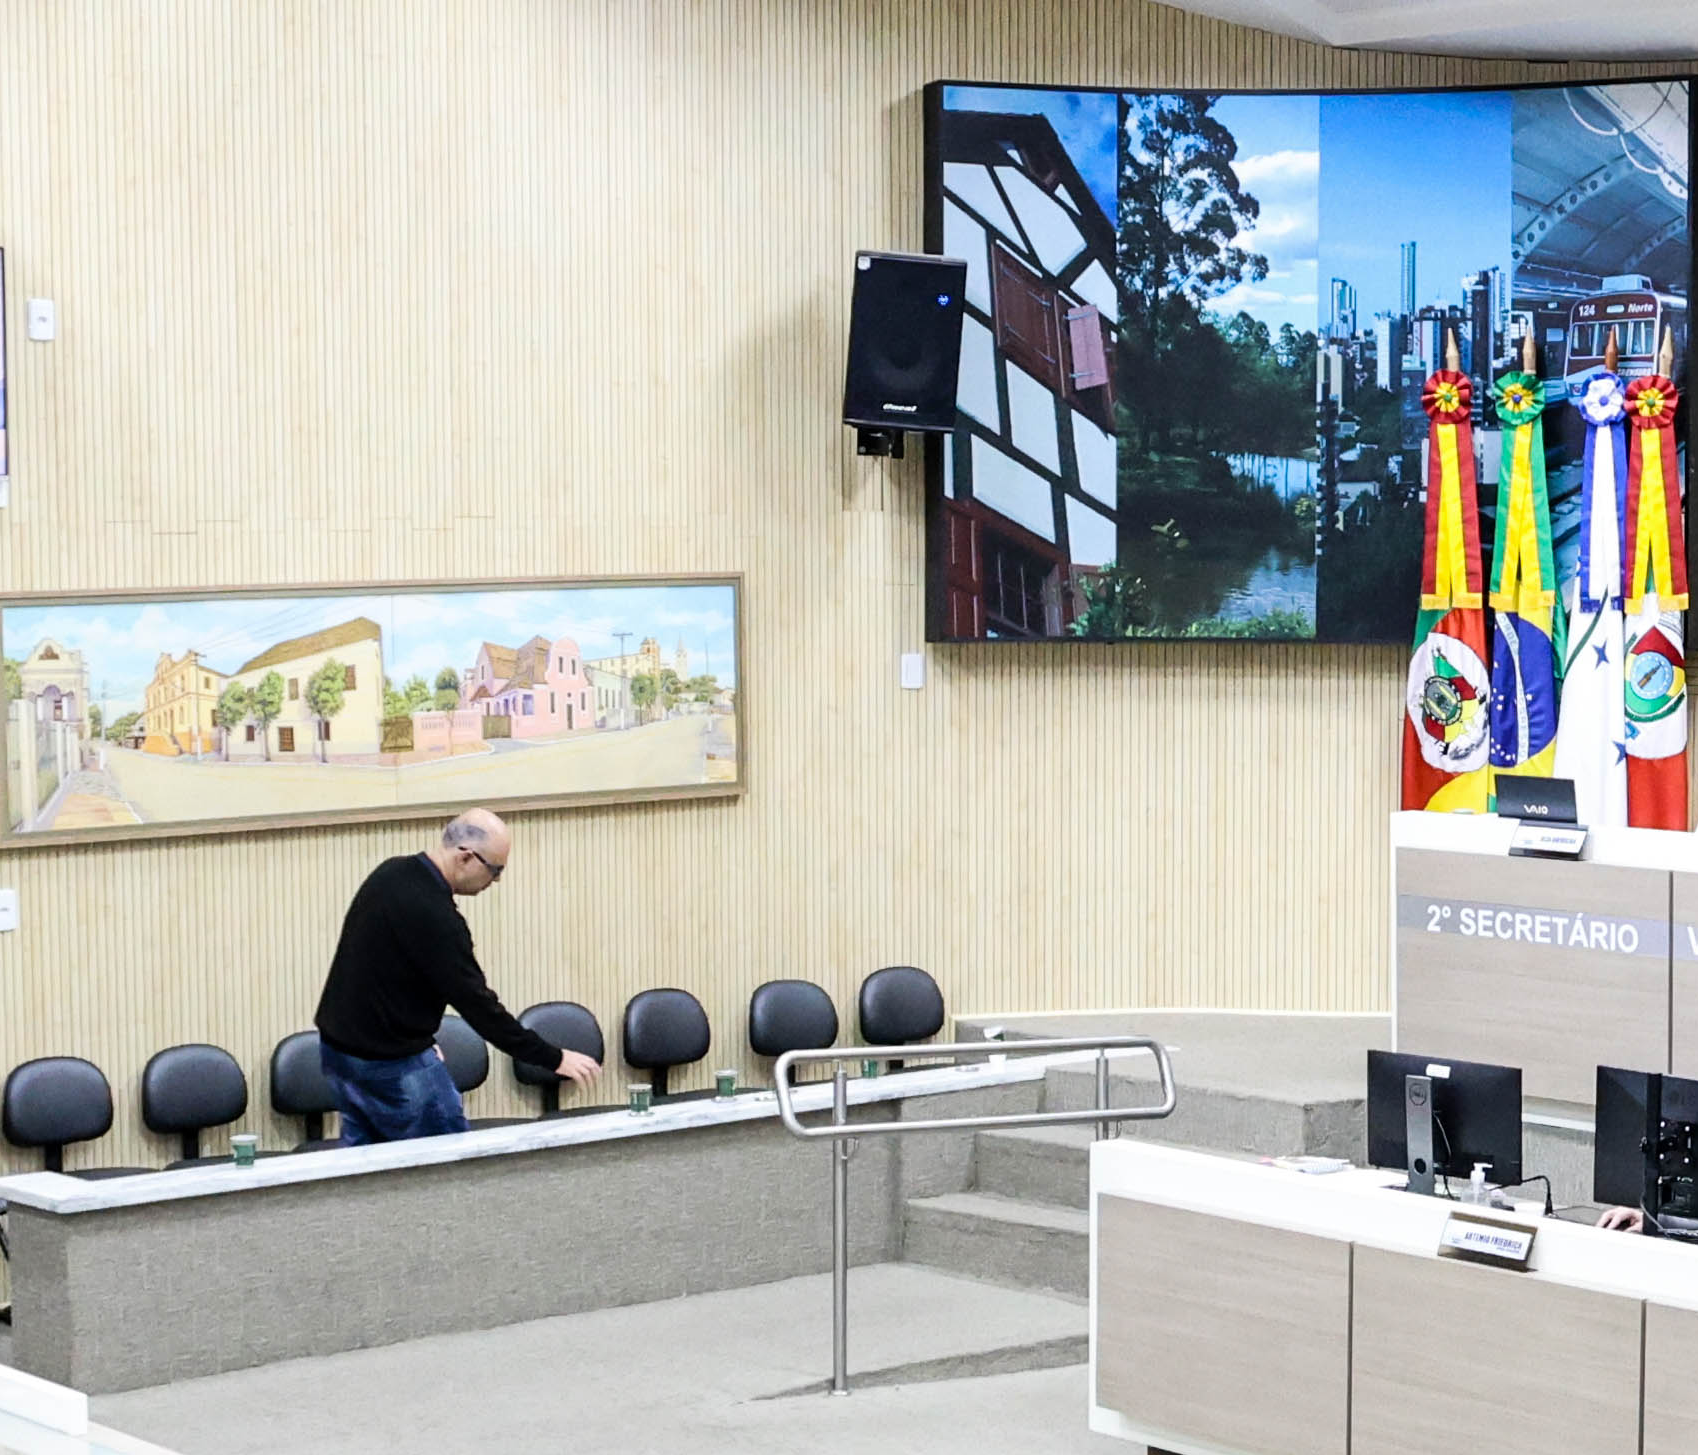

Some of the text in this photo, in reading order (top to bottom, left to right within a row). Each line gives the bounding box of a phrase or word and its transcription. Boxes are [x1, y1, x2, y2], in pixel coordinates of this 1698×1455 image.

[1578, 303, 1655, 317] 124 Norte
[1523, 803, 1549, 815] VAIO
[1460, 905, 1641, 955] SECRETÁRIO
